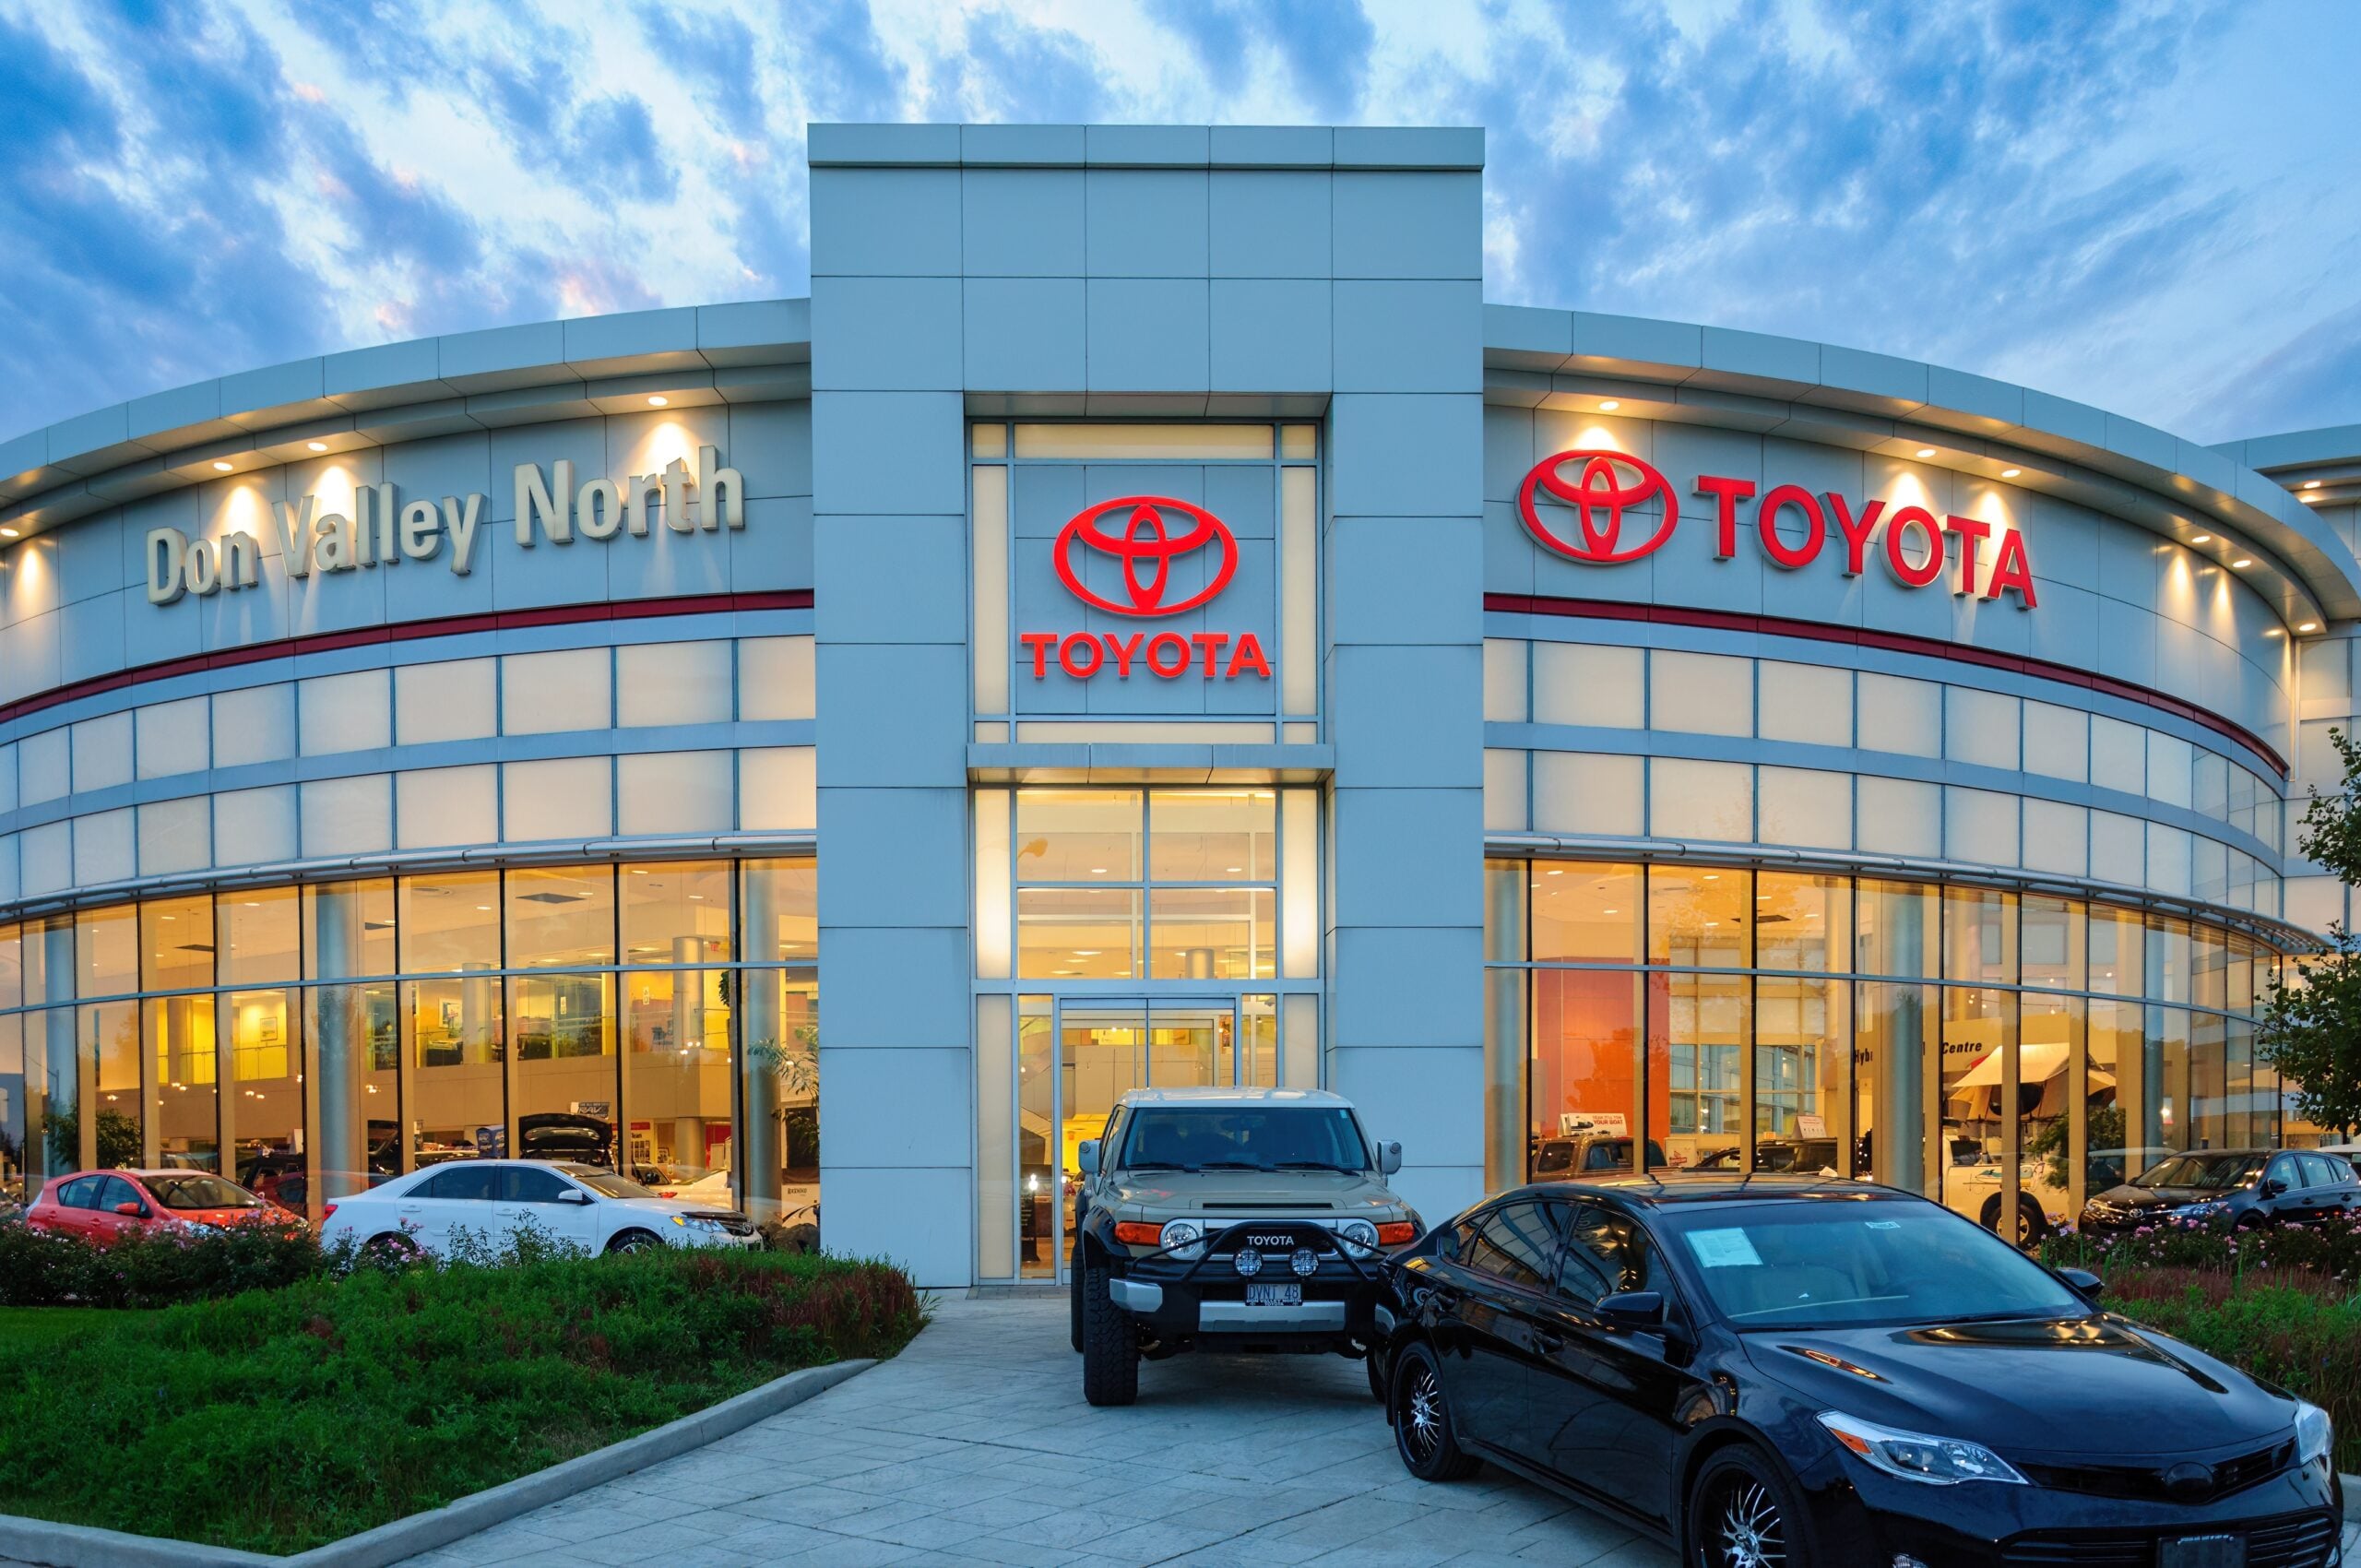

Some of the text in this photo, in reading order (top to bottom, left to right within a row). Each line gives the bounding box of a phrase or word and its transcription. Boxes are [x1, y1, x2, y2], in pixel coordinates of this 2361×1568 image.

[147, 445, 746, 606] Don Valley North
[1691, 474, 2038, 612] TOYOTA
[1019, 631, 1273, 680] TOYOTA
[1942, 1041, 1983, 1055] Centre
[1247, 1236, 1294, 1245] TOYOTA
[1285, 1285, 1299, 1299] 48
